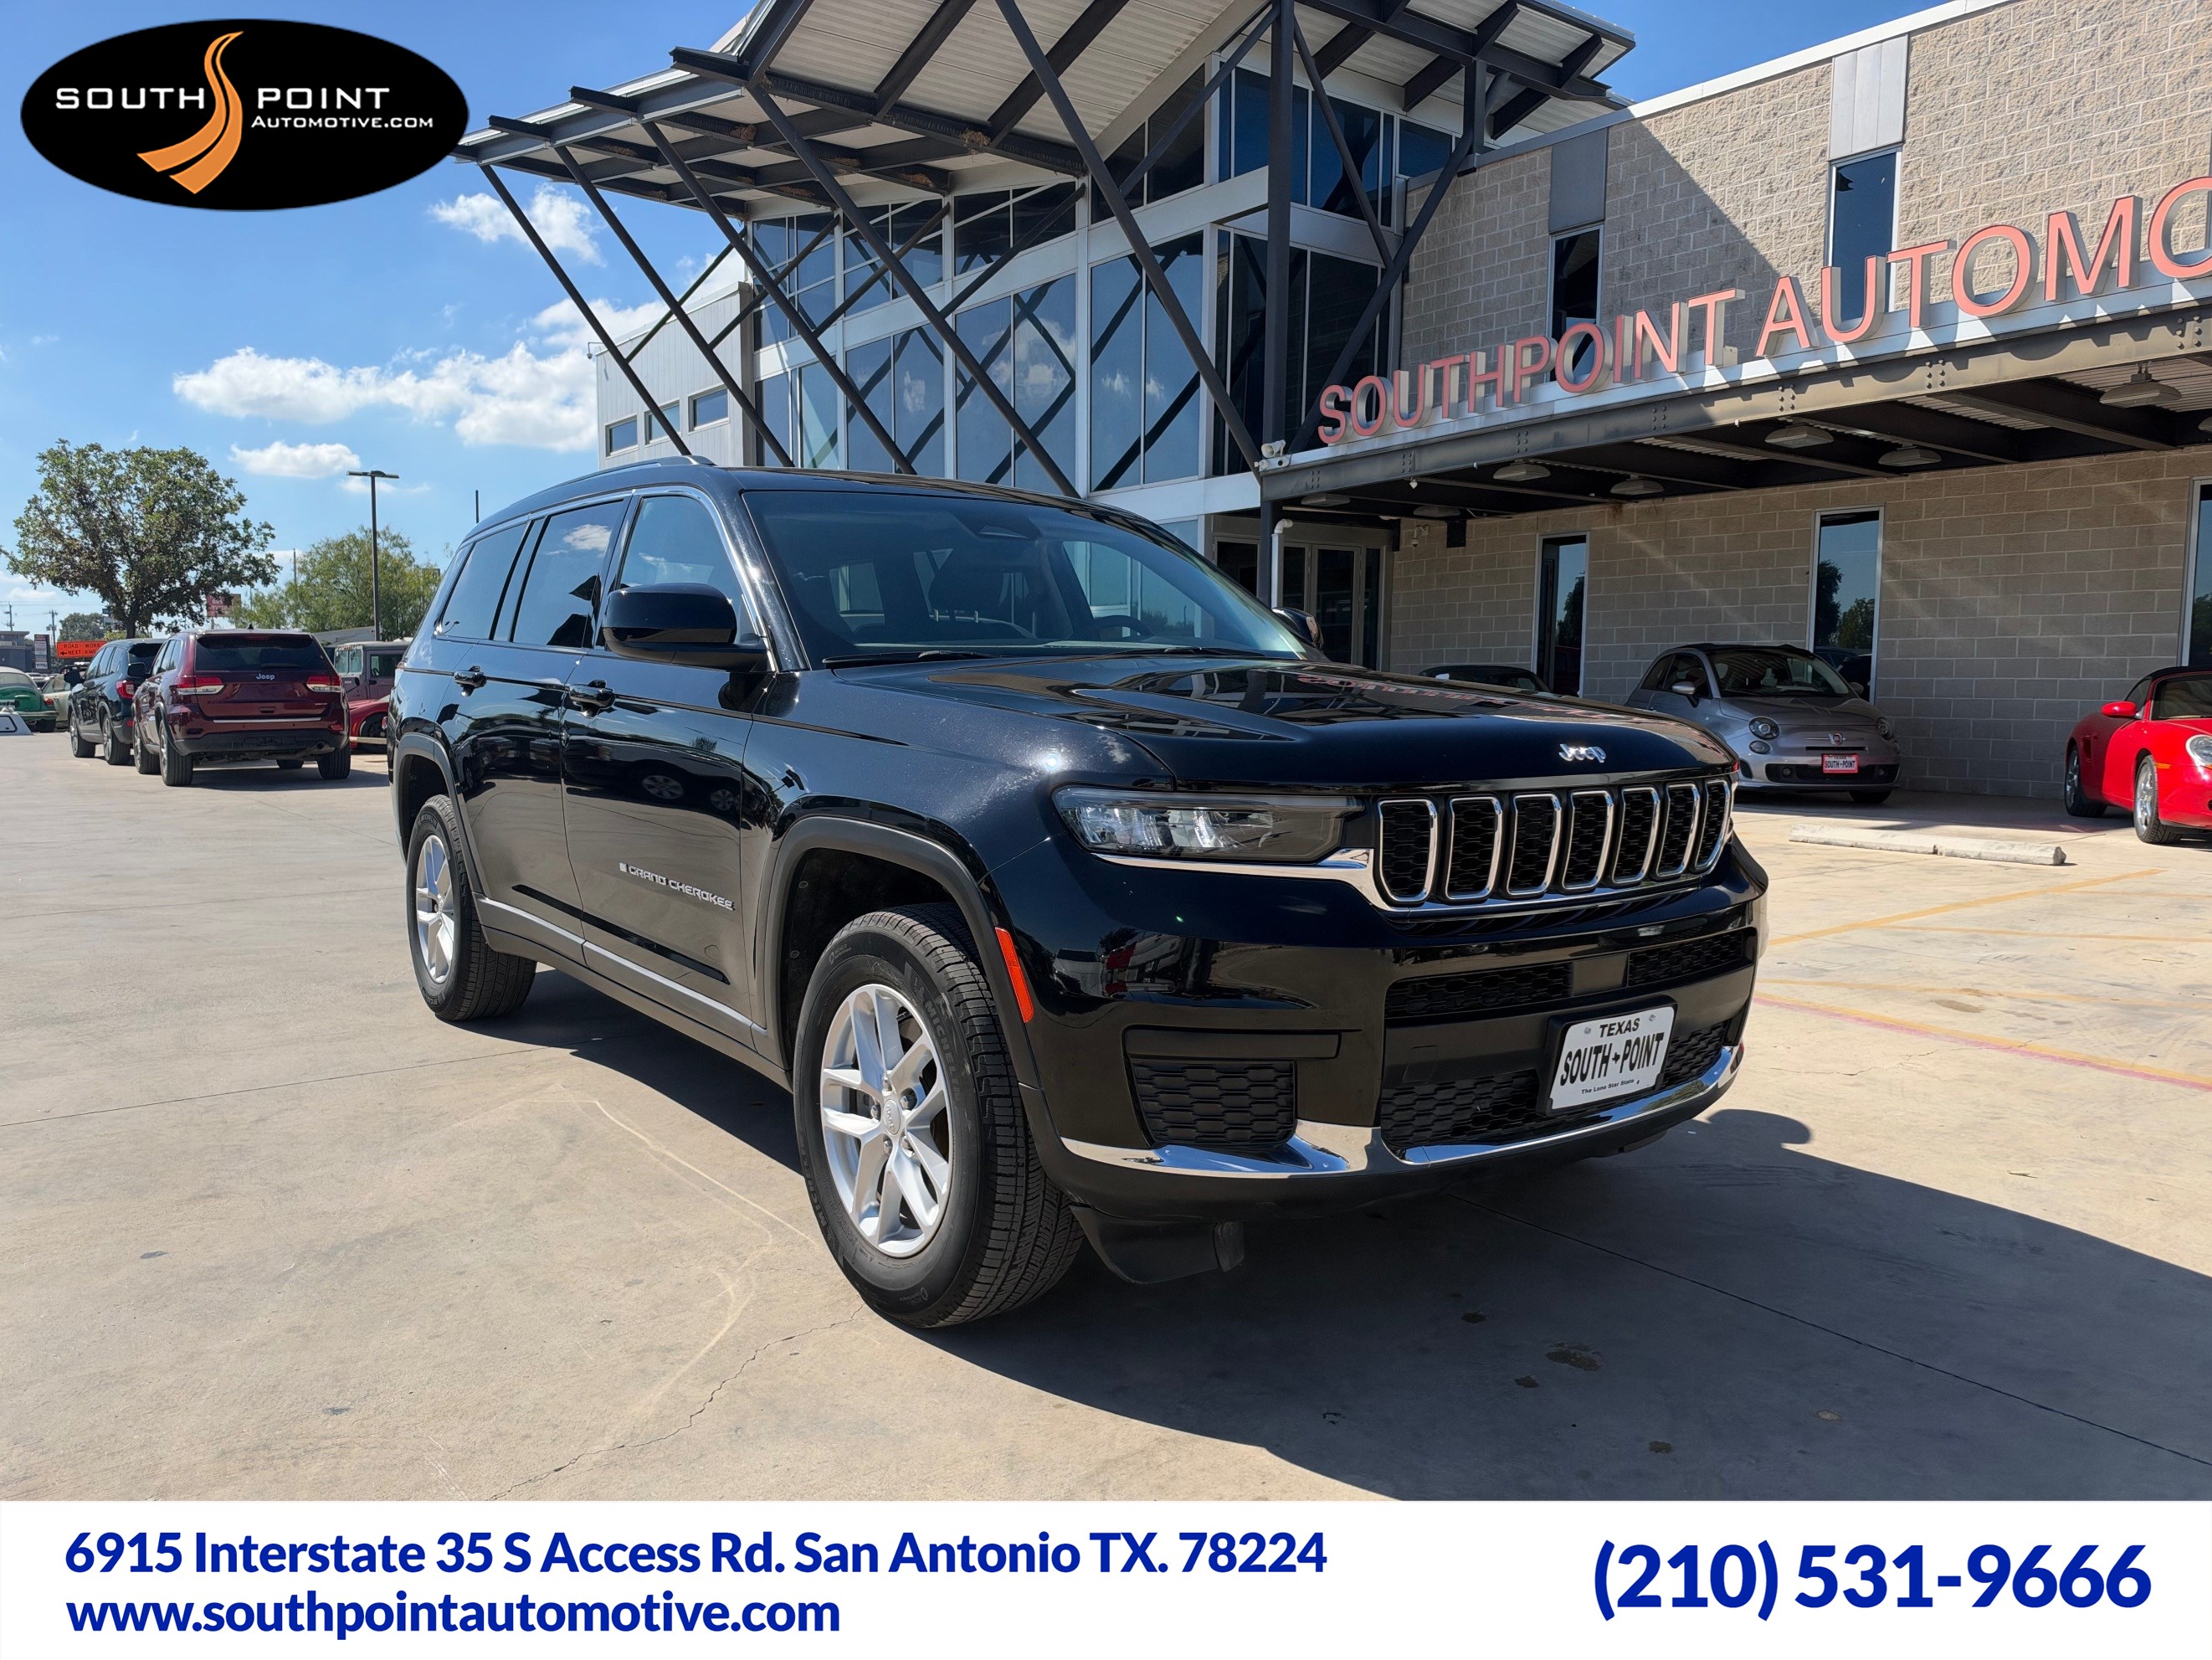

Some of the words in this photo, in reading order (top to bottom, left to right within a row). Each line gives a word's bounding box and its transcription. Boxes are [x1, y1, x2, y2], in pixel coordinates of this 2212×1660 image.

[1317, 287, 1746, 445] SOUTHPOINT
[629, 865, 667, 886] GRAND
[669, 879, 735, 911] CHEROKEE
[1599, 1017, 1640, 1038] TEXAS
